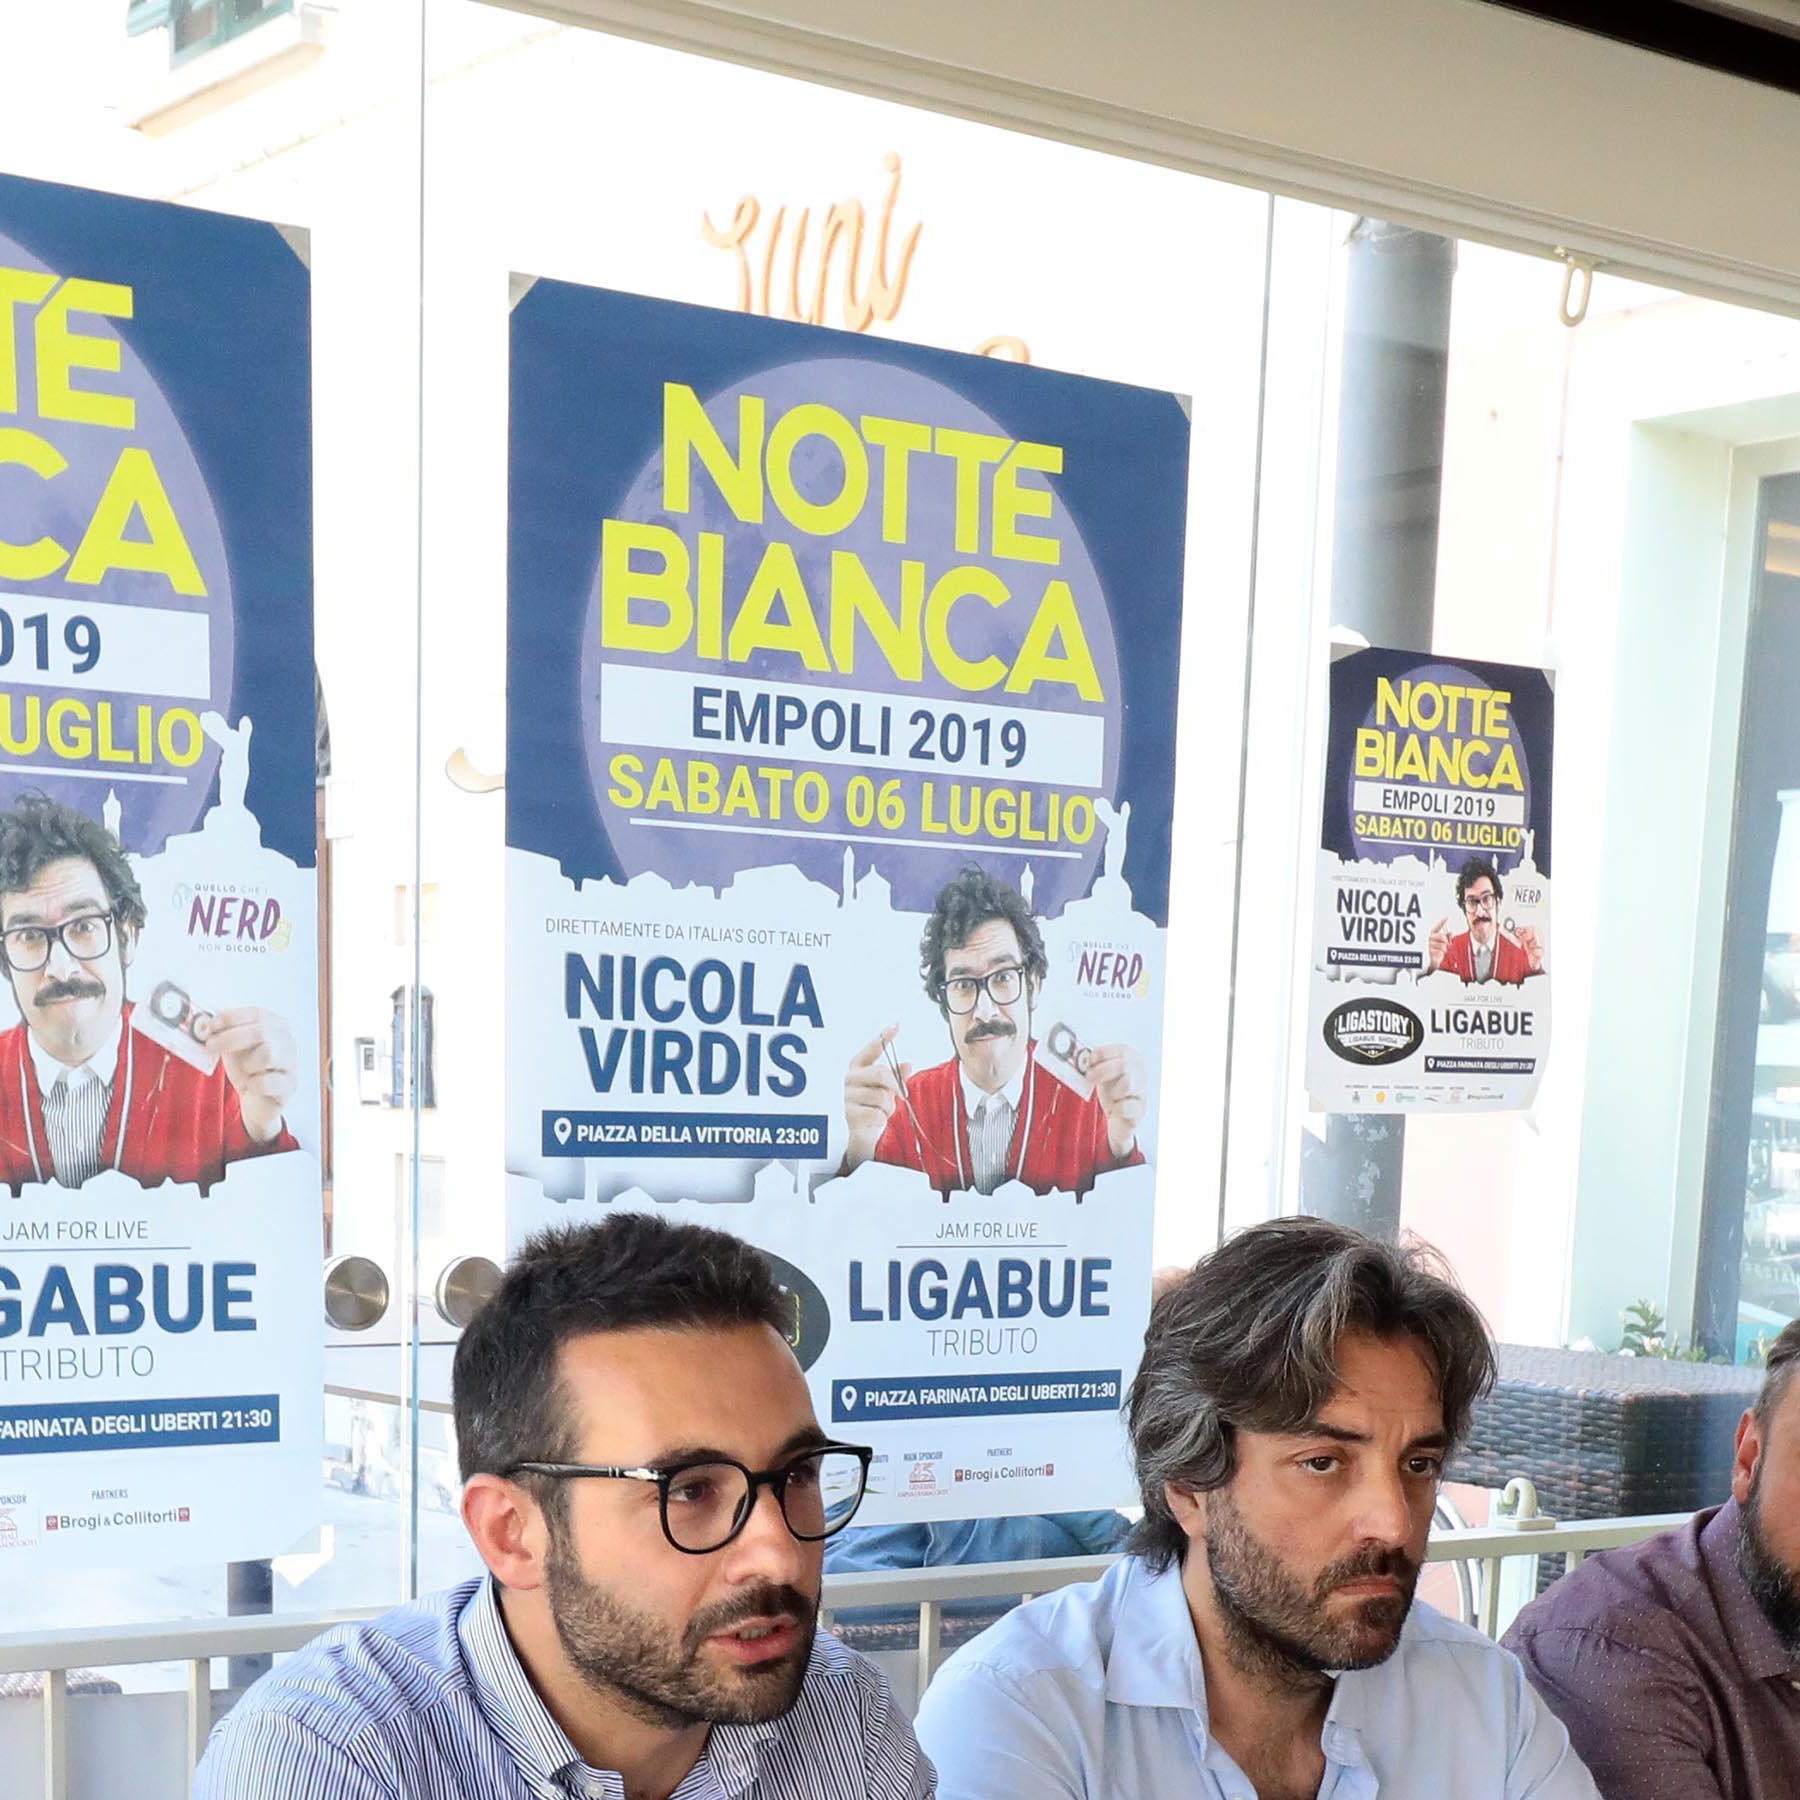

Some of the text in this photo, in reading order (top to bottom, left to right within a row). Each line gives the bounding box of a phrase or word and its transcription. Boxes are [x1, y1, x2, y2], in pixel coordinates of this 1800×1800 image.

[663, 381, 1063, 566] NOTTE
[601, 518, 1104, 702] BIANCA
[1375, 677, 1511, 739] NOTTE
[691, 685, 1027, 768] EMPOLI 2019
[1355, 726, 1525, 792] BIANCA
[607, 753, 1095, 844] SABATO 06 LUGLIO
[1382, 788, 1495, 818] EMPOLI 2019
[1355, 815, 1520, 848] SABATO 06 LUGLIO
[195, 883, 236, 893] QUELLO
[1514, 887, 1541, 904] NERD
[188, 894, 280, 942] NERD
[1336, 888, 1422, 919] NICOLA
[546, 918, 831, 948] DIRETTAMENTE DA ITALIA'S GOT TALENT
[1341, 916, 1416, 945] VIRDIS
[226, 945, 266, 953] DICONO
[1077, 950, 1143, 990] NERD
[565, 951, 824, 1028] NICOLA
[1337, 1010, 1410, 1035] LIGASTORY
[1431, 1008, 1533, 1036] LIGABUE
[578, 1026, 808, 1098] VIRDIS
[577, 1125, 819, 1145] PIAZZA DELLA VITTORIA 23:00
[3, 1220, 148, 1242] JAM FOR LIVE
[936, 1222, 1039, 1239] JAM FOR LIVE
[849, 1257, 1112, 1322] LIGABUE
[927, 1327, 1038, 1356] TRIBUTO
[865, 1382, 1116, 1408] PIAZZA FARINATA DEGLI UBERTI 21:30
[92, 1414, 146, 1437] DEGLI
[151, 1411, 218, 1434] UBERTI
[221, 1409, 271, 1432] 21:30
[964, 1464, 1045, 1482] Brogi Collitorti
[91, 1488, 129, 1500] PARTNERS
[60, 1508, 178, 1531] Brogi Collitorti
